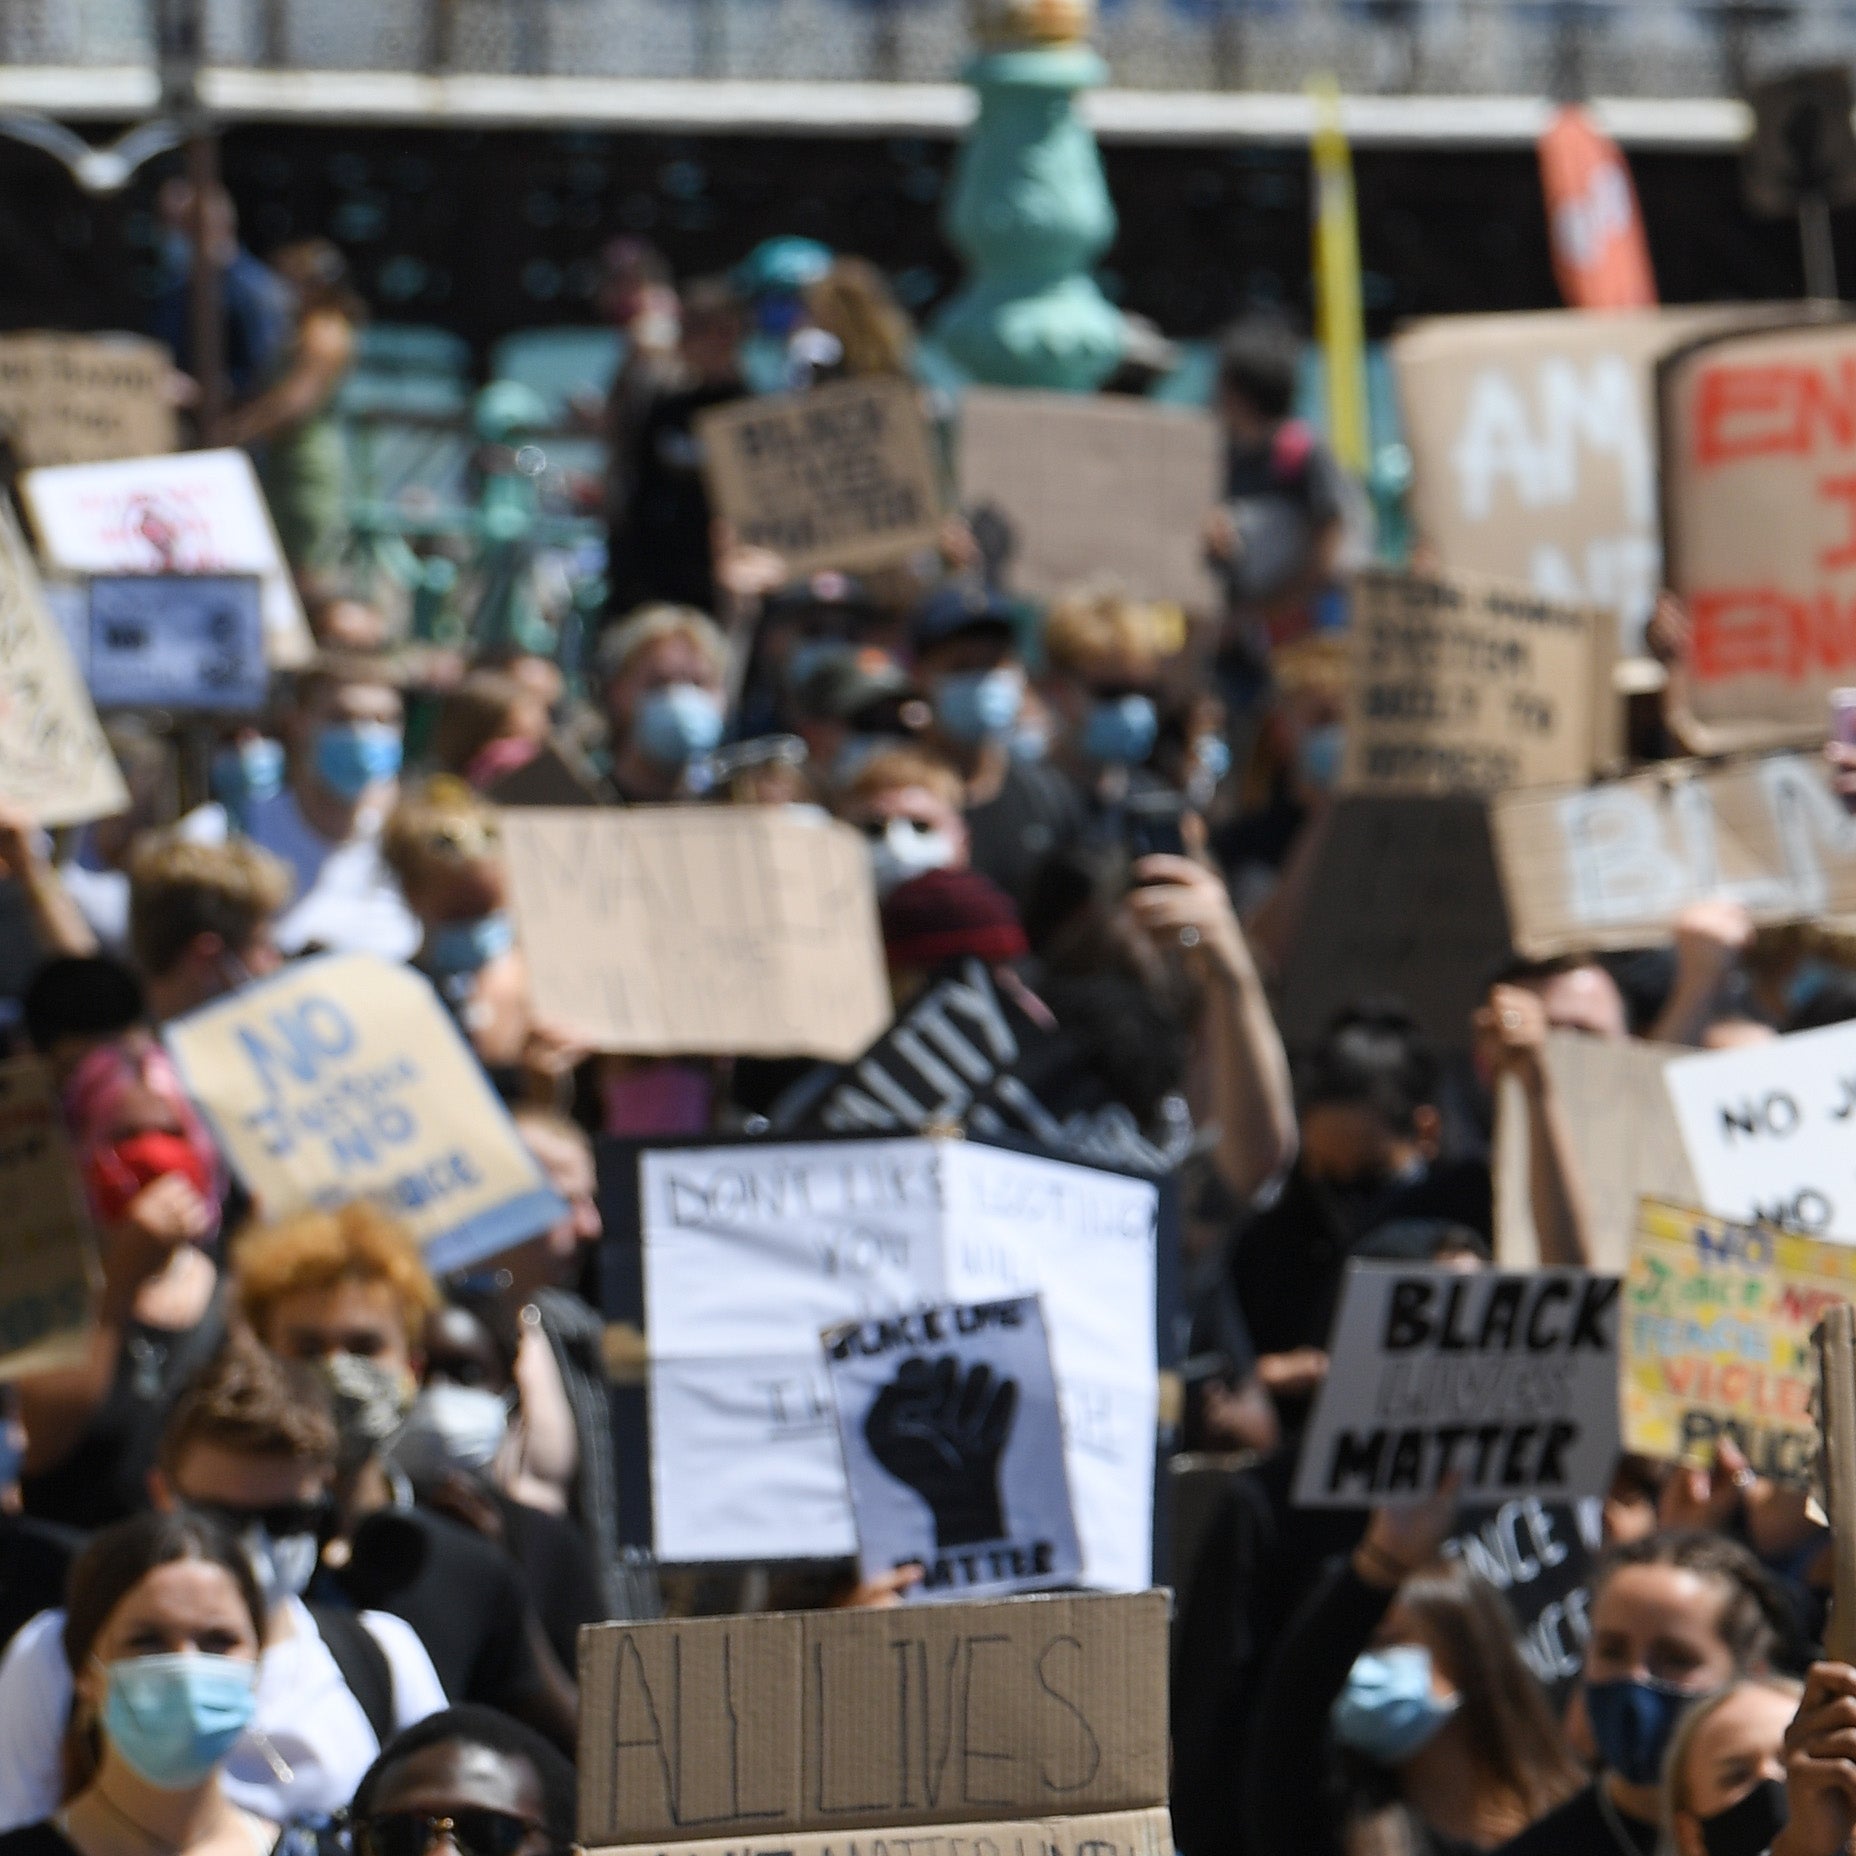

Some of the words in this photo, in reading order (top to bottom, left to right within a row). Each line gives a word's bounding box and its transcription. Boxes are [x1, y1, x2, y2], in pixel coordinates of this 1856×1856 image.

[236, 994, 359, 1096] NO
[330, 1105, 417, 1166] NO
[1718, 1087, 1801, 1149] NO
[1754, 1186, 1838, 1241] NO
[1694, 1224, 1777, 1273] NO
[1383, 1275, 1621, 1353] BLACK
[1380, 1355, 1579, 1420] LIVES
[1327, 1419, 1581, 1496] MATTER
[610, 1632, 788, 1829] ALL
[812, 1632, 1102, 1817] LIVES
